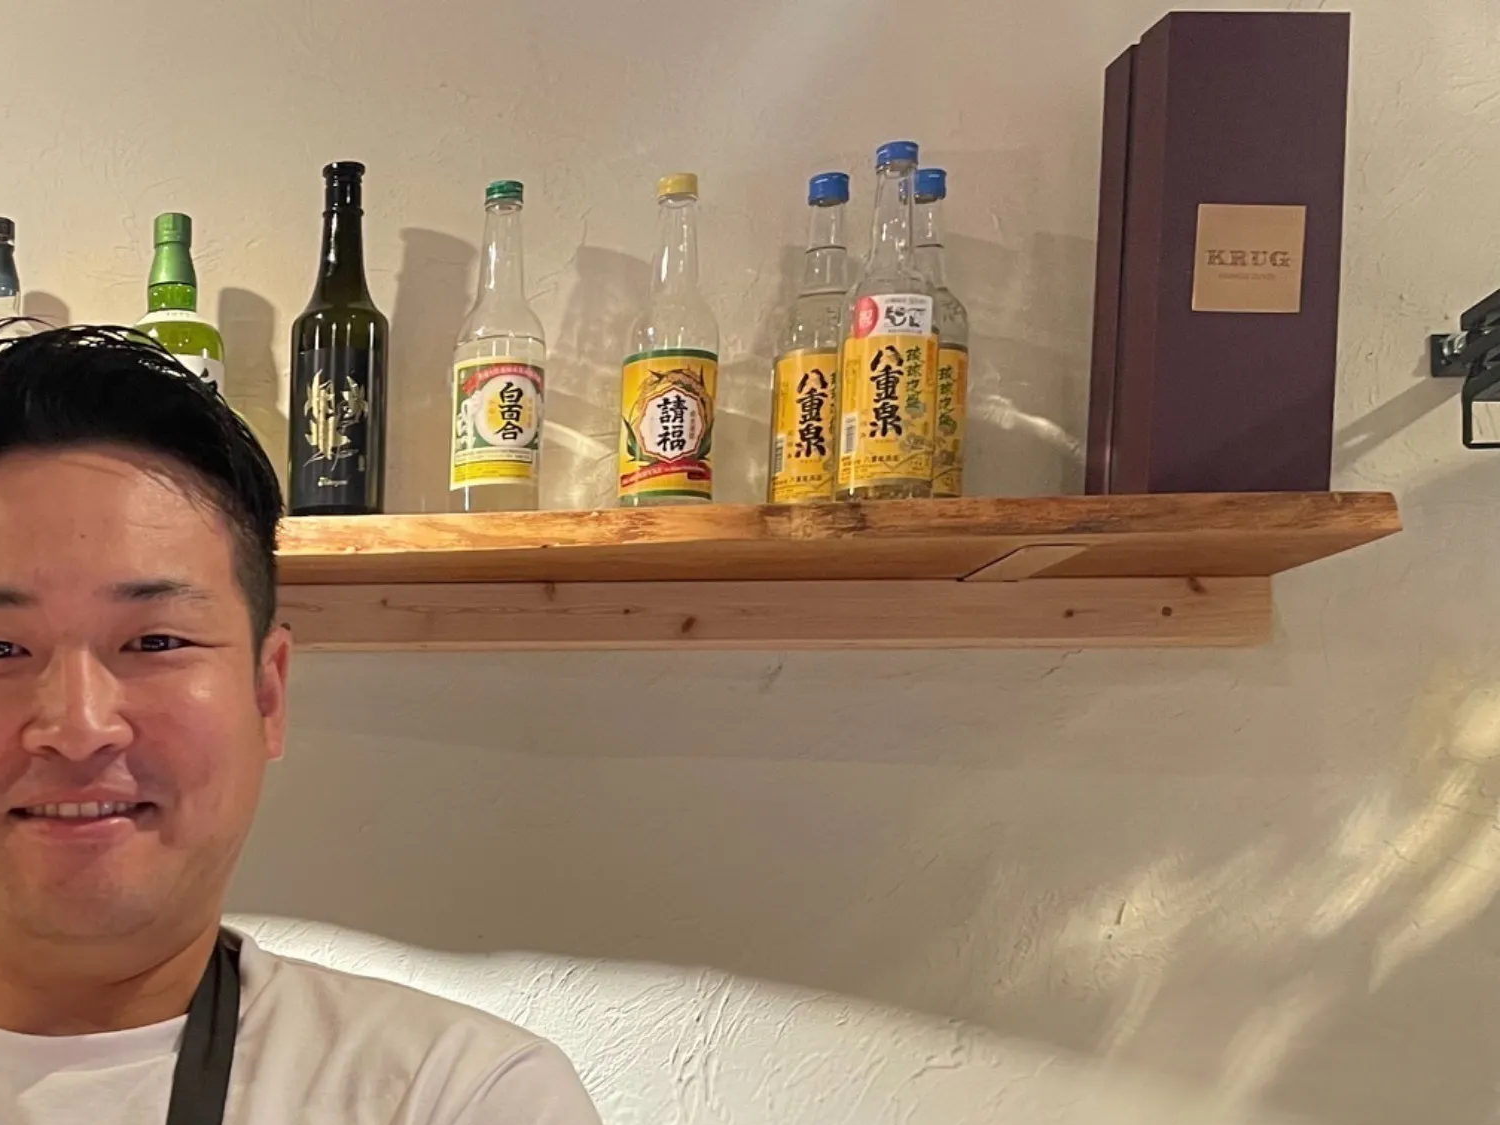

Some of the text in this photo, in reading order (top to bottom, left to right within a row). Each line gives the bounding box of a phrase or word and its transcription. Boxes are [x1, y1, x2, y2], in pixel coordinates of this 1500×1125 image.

[1206, 249, 1291, 267] KRUG
[495, 381, 524, 441] 白百合
[794, 368, 829, 459] 八重泉
[868, 345, 905, 438] 八重泉
[656, 394, 688, 452] 請福
